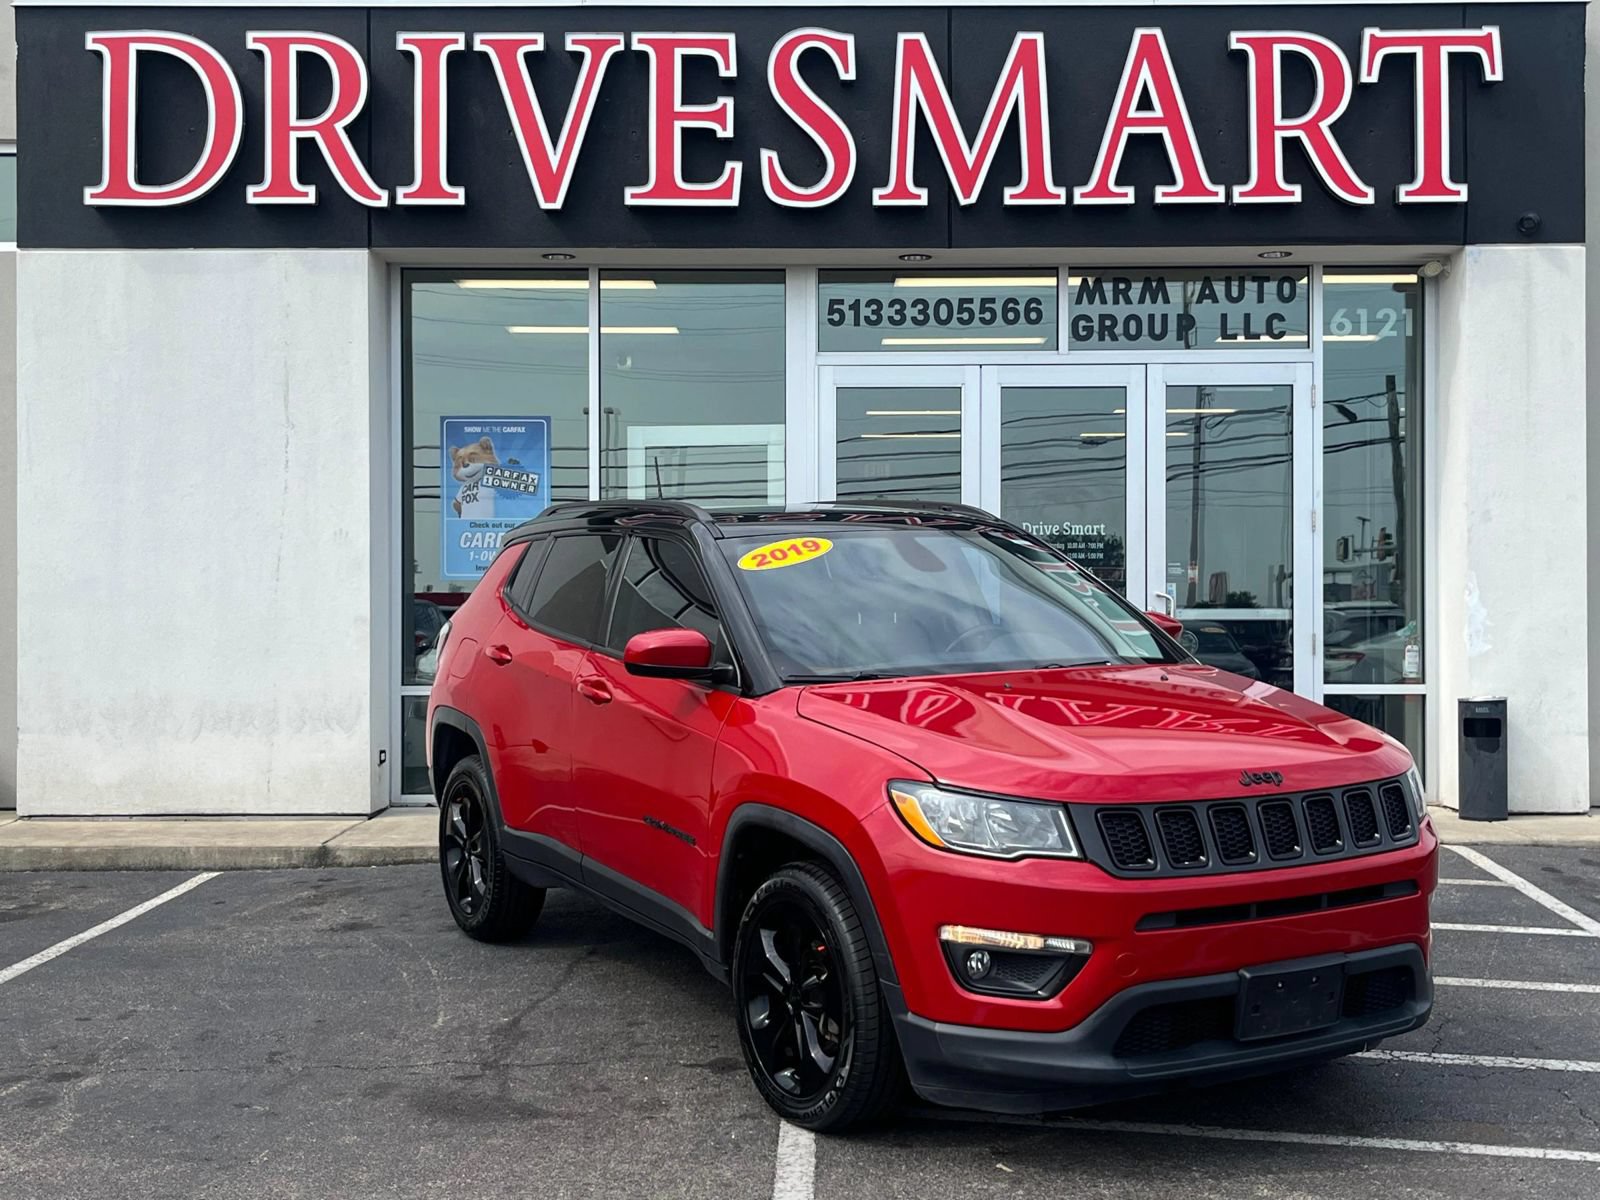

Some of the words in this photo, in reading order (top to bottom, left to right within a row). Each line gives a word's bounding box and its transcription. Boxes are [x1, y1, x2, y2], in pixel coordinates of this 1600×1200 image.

[83, 25, 1504, 210] DRIVESMART
[1075, 276, 1170, 305] MRM
[1197, 275, 1297, 304] AUTO
[827, 297, 1044, 327] 5133305566
[1329, 307, 1413, 337] 6121
[1071, 313, 1196, 343] GROUP
[1219, 312, 1287, 341] LLC
[485, 466, 539, 484] CARFAX
[469, 521, 490, 529] Check
[1022, 521, 1060, 536] Drive
[1062, 521, 1106, 536] Smart
[750, 539, 822, 569] 2019
[1239, 769, 1284, 787] Jeep
